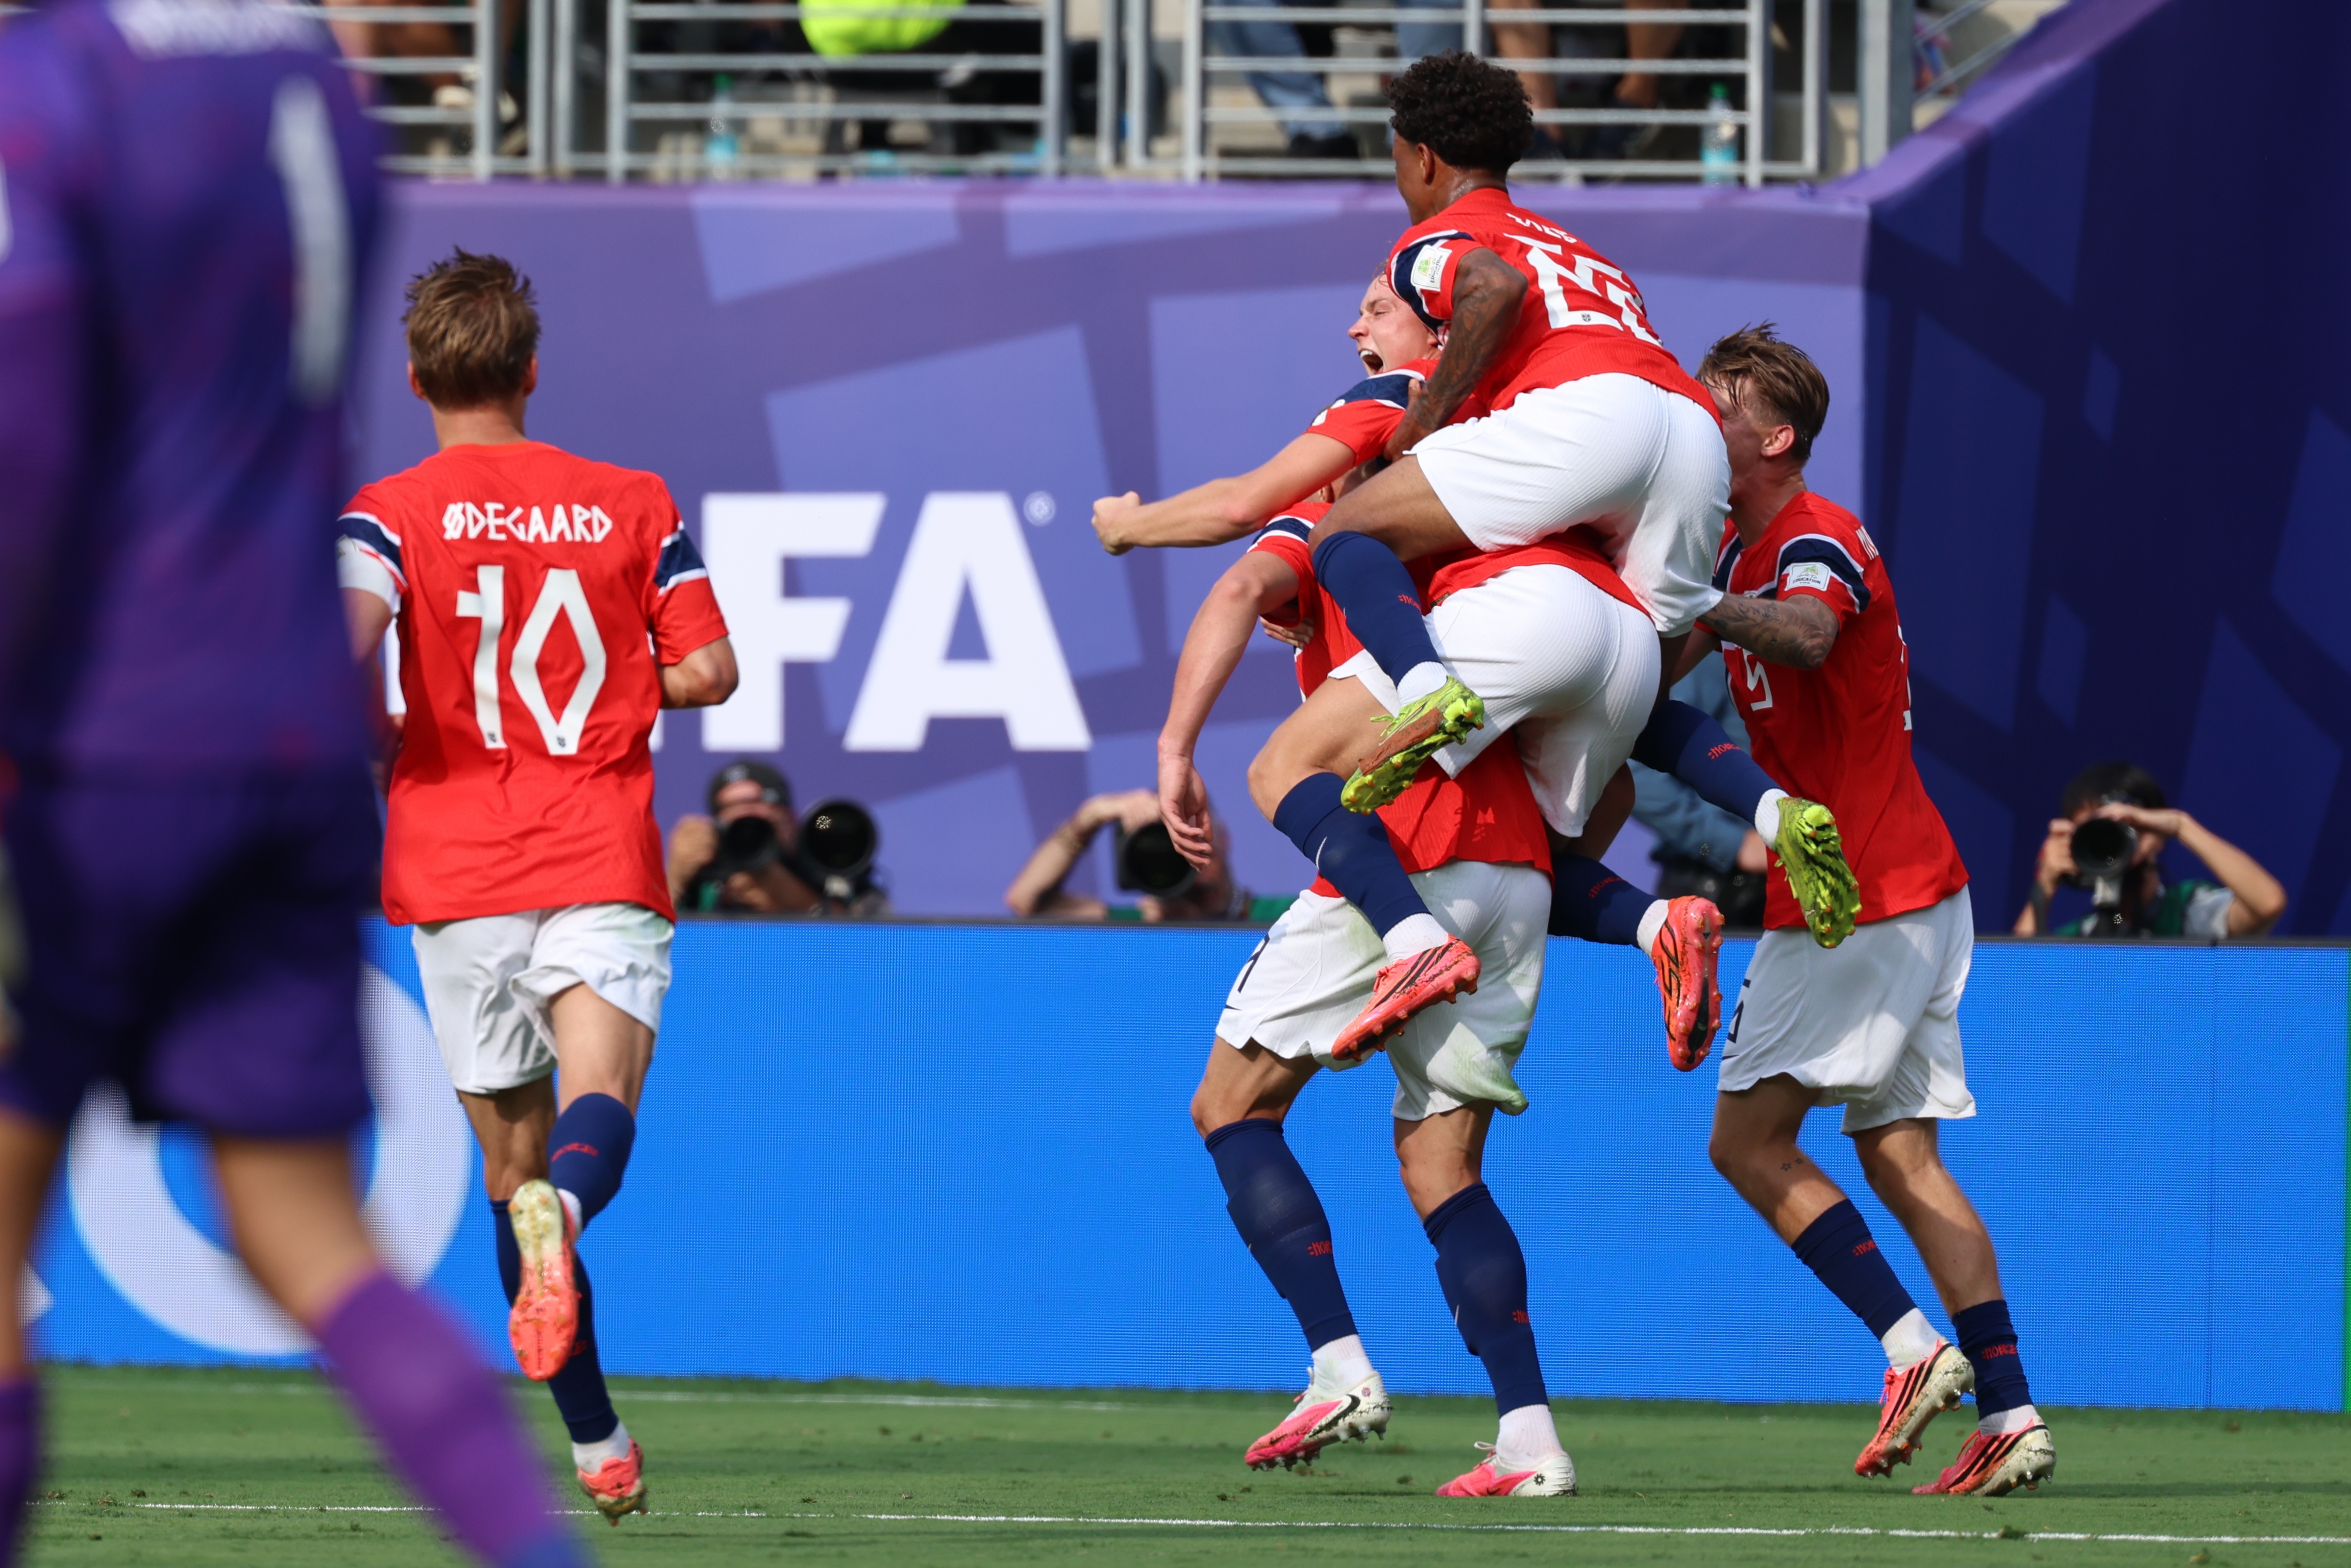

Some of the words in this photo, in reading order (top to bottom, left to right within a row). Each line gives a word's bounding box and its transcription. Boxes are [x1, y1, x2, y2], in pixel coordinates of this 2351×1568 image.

[442, 501, 613, 543] ØDEGAARD
[455, 564, 607, 756] 10
[648, 491, 1093, 751] FA
[1742, 648, 1773, 712] 5
